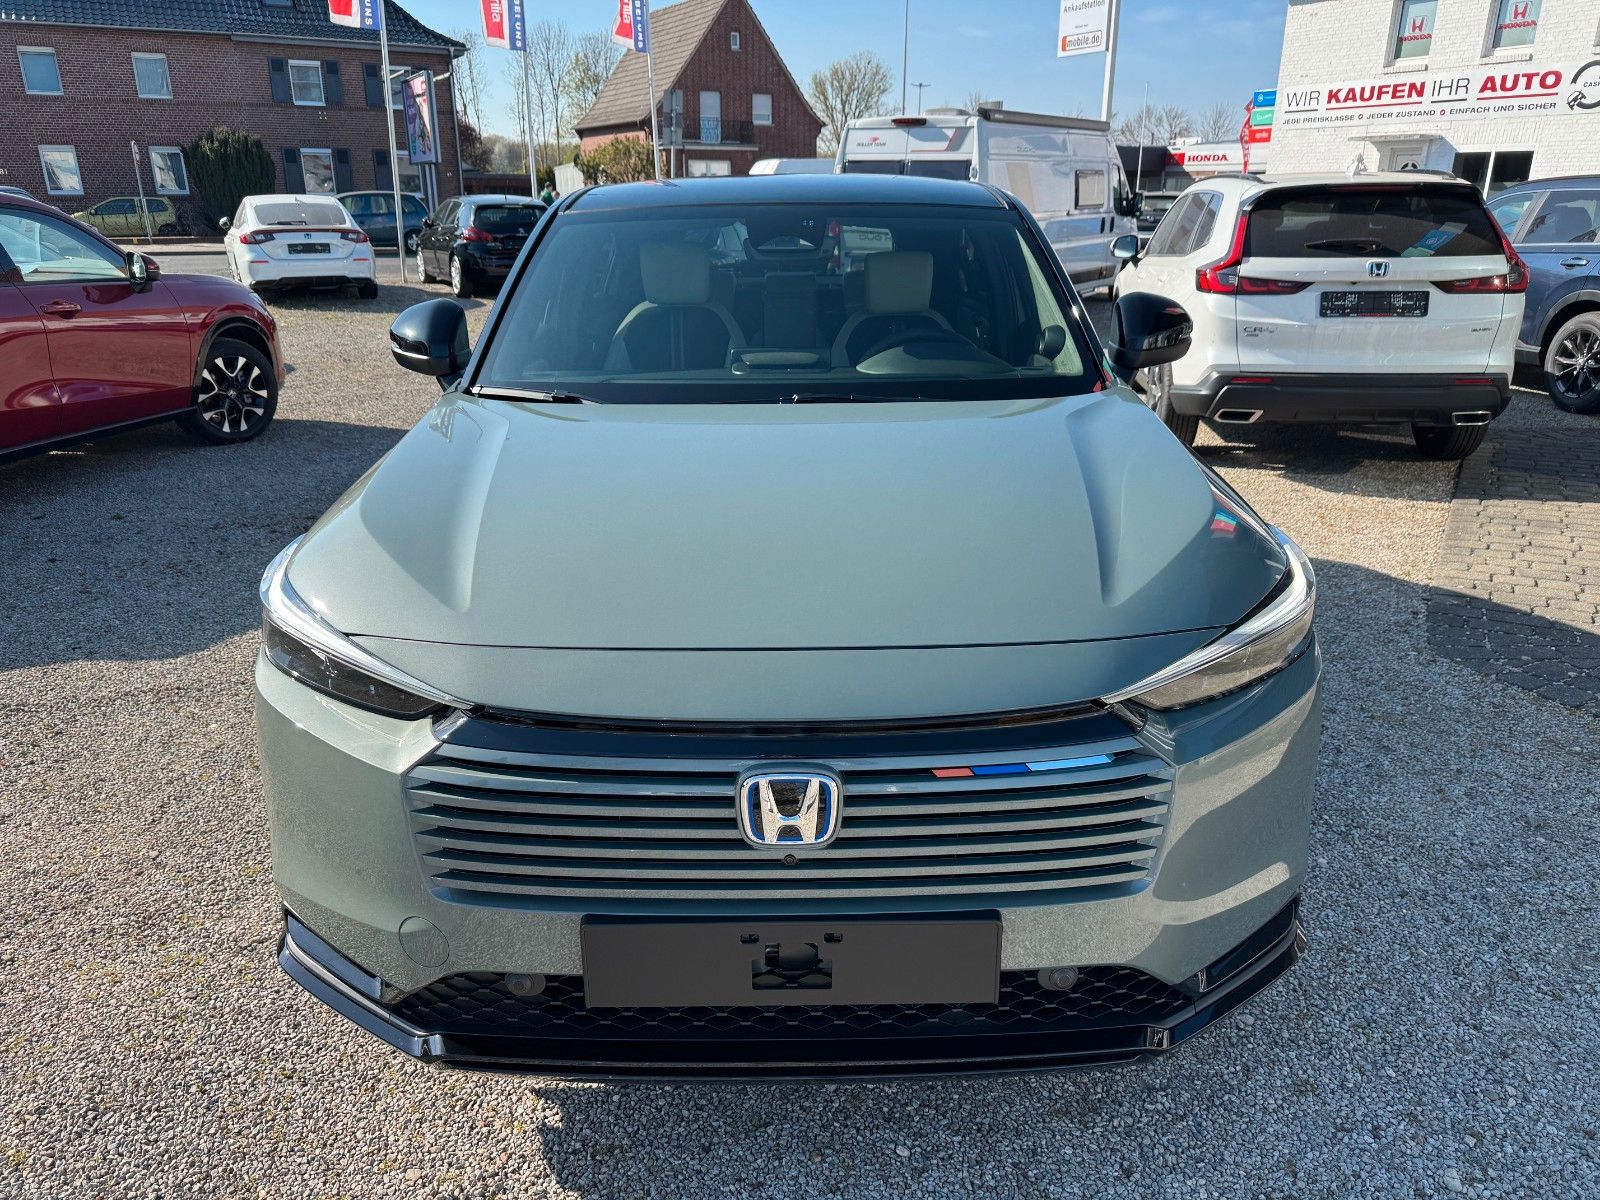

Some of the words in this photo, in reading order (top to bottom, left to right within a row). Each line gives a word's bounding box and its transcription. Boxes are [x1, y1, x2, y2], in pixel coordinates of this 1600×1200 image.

[1066, 34, 1100, 48] mobile.de
[1286, 90, 1321, 108] WIR
[1326, 81, 1426, 105] KAUFEN
[1431, 78, 1471, 97] IHR
[1478, 70, 1563, 94] AUTO
[1302, 114, 1355, 124] PREISKLASSE
[1366, 112, 1393, 120] JEDER
[1395, 109, 1436, 118] ZUSTAND
[1449, 105, 1490, 115] EINFACH
[1493, 104, 1515, 112] UND
[1517, 102, 1557, 111] SICHER
[1187, 154, 1229, 163] HONDA
